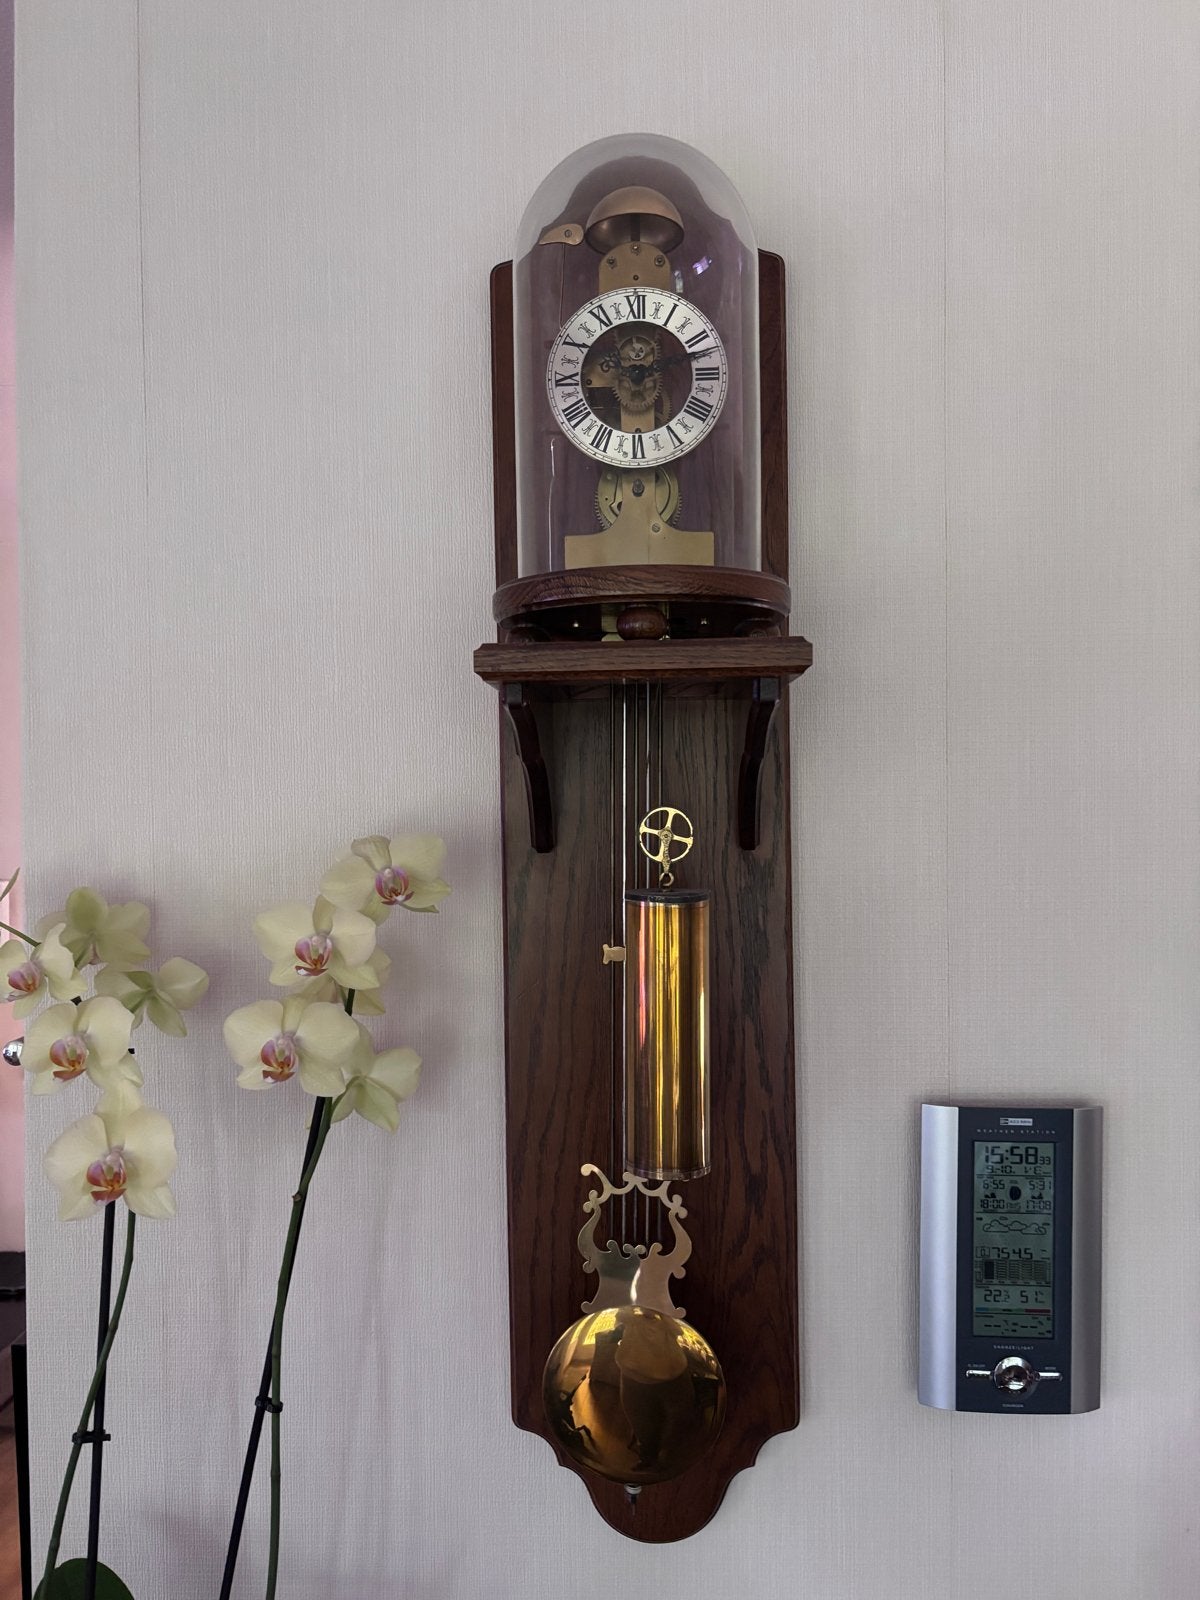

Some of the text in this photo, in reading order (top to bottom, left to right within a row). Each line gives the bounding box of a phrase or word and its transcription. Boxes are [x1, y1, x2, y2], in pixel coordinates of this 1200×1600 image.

[587, 303, 613, 331] XI
[624, 294, 647, 320] XII
[662, 303, 679, 328] I
[562, 333, 591, 354] X
[684, 328, 710, 349] II
[555, 370, 580, 389] IX
[694, 366, 720, 382] III
[561, 398, 592, 431] VIII
[683, 395, 714, 424] IIII
[589, 423, 613, 453] VII
[630, 434, 647, 459] VI
[665, 424, 685, 450] V
[985, 1146, 1038, 1165] 15:58
